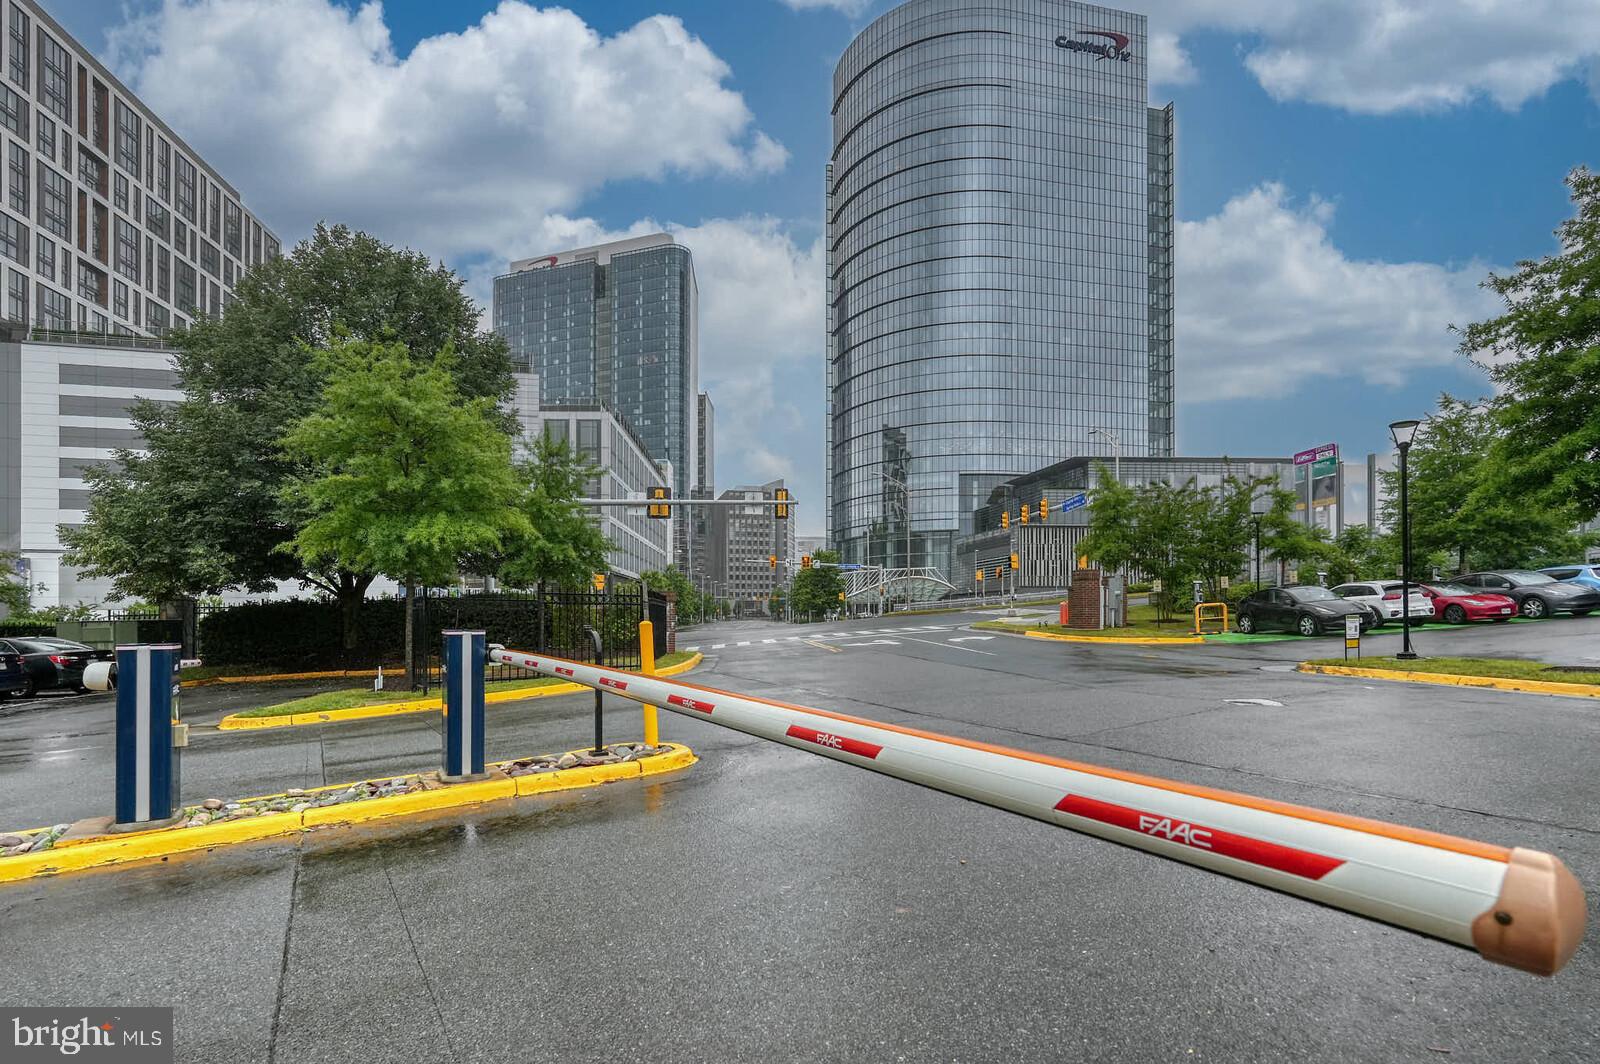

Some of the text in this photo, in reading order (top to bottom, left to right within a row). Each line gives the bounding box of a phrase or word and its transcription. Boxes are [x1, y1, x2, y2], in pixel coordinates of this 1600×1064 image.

[1055, 35, 1131, 62] Capital One
[816, 733, 842, 748] FAAC
[1139, 815, 1212, 848] FAAC
